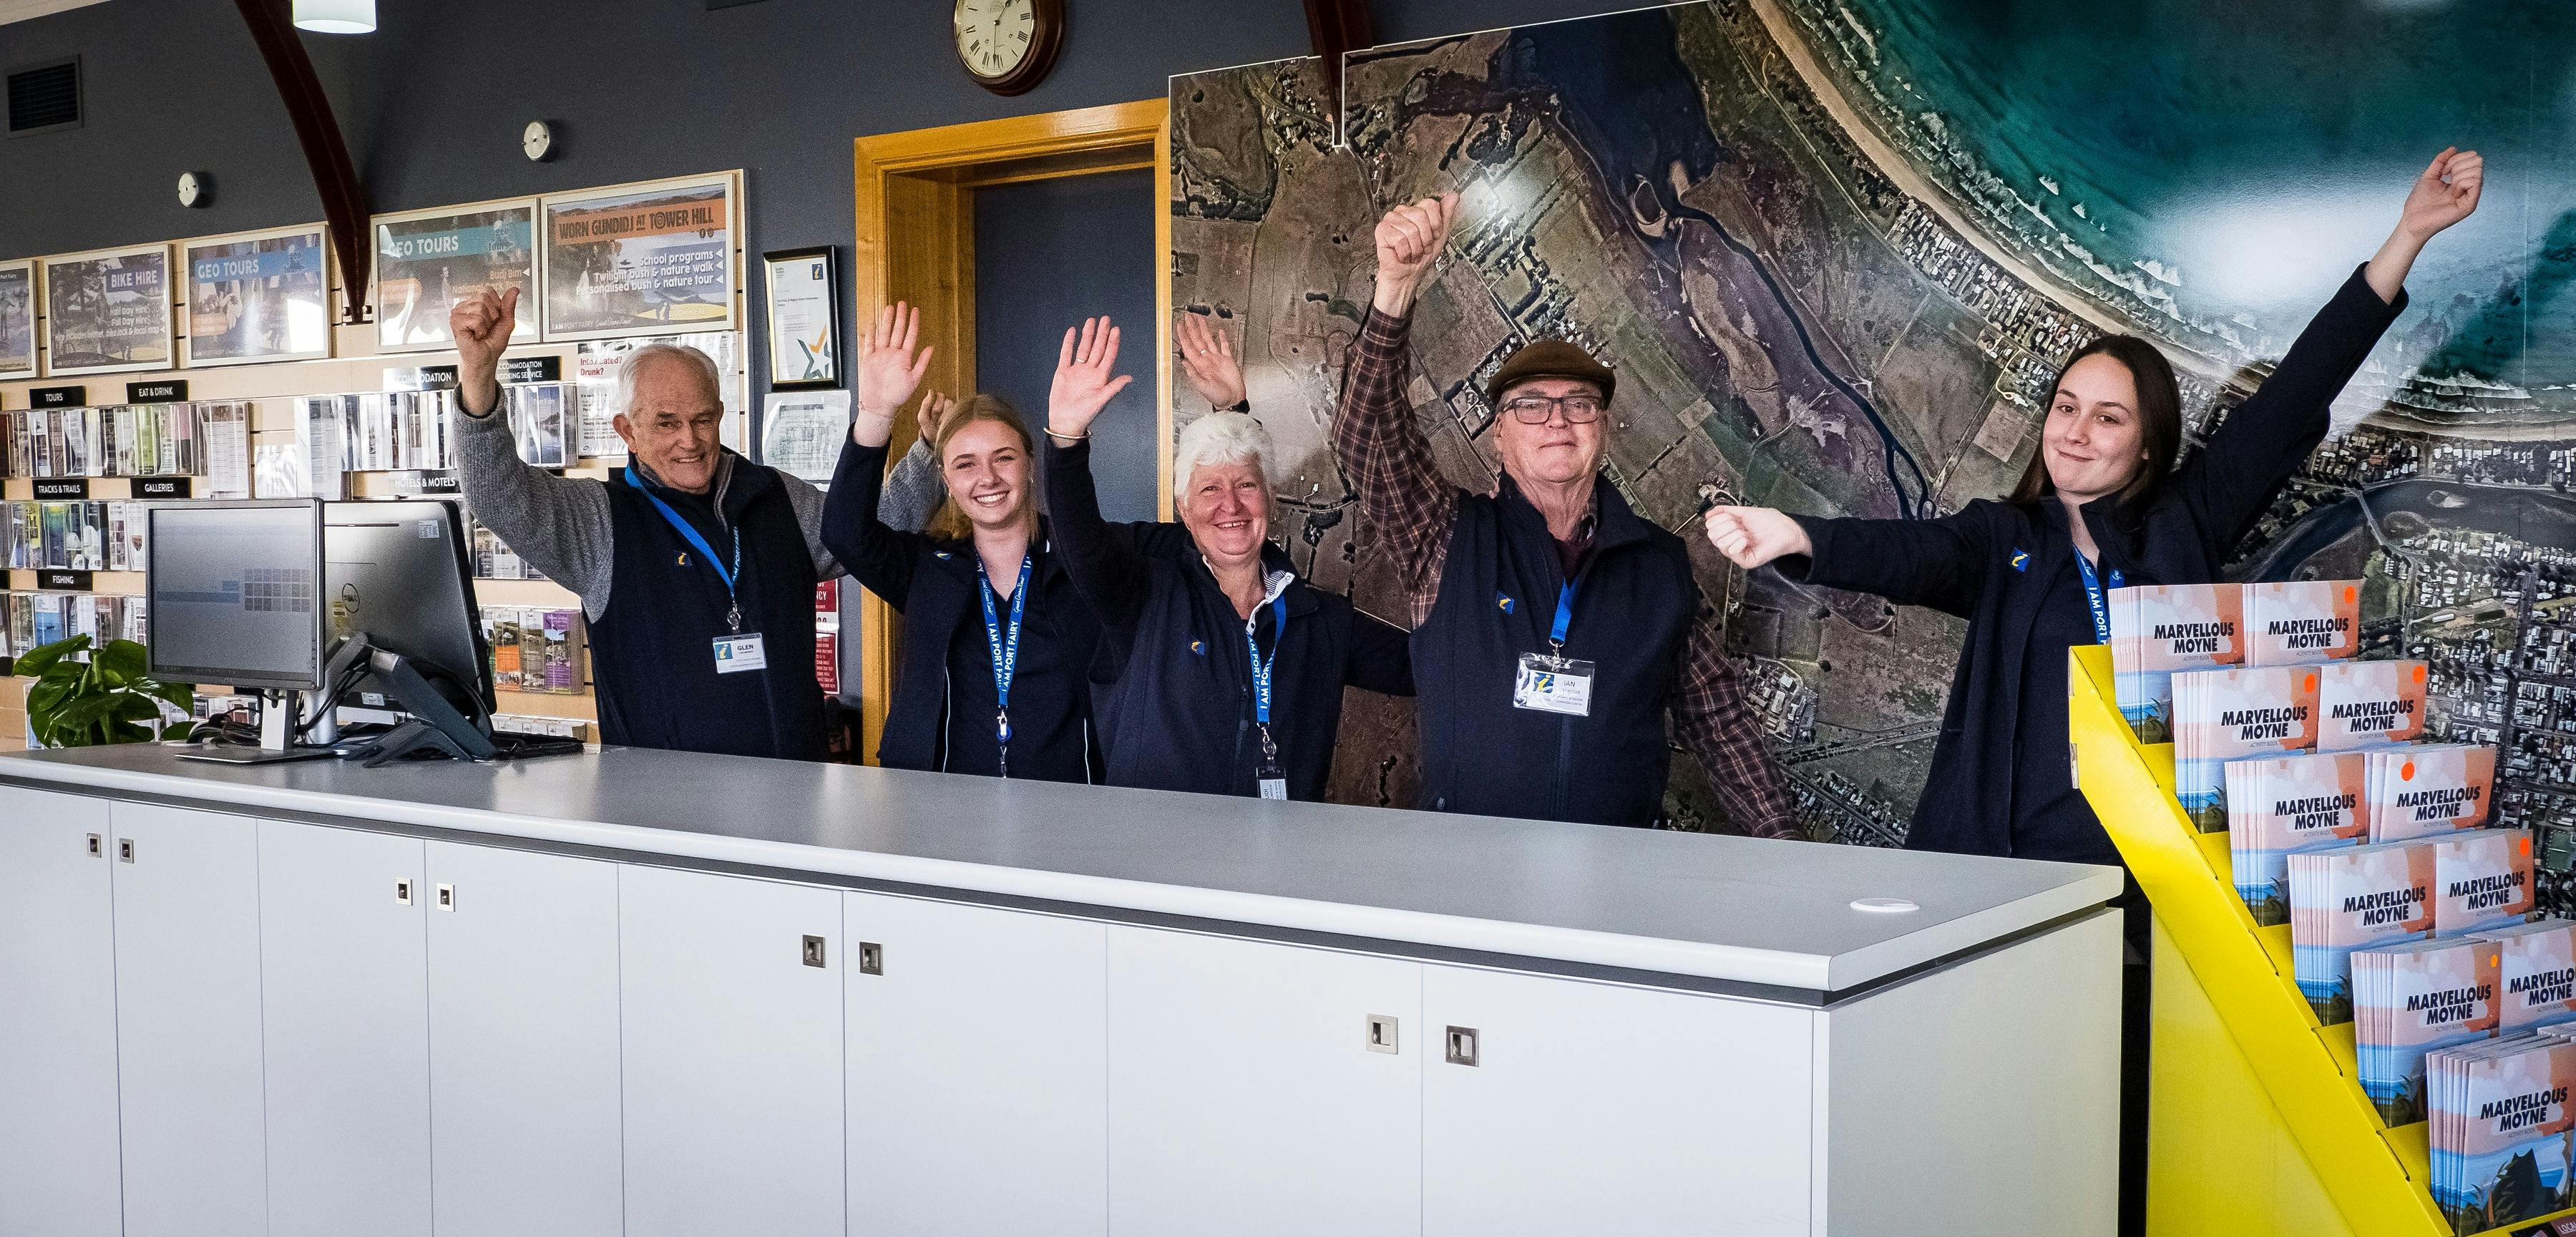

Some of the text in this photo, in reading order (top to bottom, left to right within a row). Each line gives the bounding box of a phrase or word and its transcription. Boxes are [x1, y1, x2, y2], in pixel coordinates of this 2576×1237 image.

[559, 207, 714, 240] WORN GUNDIDJ AT TOWER HILL
[416, 235, 459, 255] TOURS
[197, 258, 259, 278] GEO TOURS
[640, 251, 714, 267] School programs
[111, 270, 158, 288] BIKE HIRE
[595, 261, 714, 283] Twilight bush & nature walk
[576, 274, 714, 295] Personalised bush & nature tour
[122, 307, 135, 316] Day
[122, 318, 135, 326] Day
[580, 356, 623, 366] Intoated?
[390, 371, 452, 384] CCOMODATION
[521, 371, 542, 379] SERVICE
[580, 368, 604, 376] Drunk?
[45, 393, 63, 402] TOURS
[139, 386, 173, 397] EAT & DRINK
[38, 484, 81, 494] TRACKS & TRAILS
[145, 483, 174, 492] GALLERIES
[395, 476, 456, 487] HOTELS & MOTELS
[52, 575, 74, 585] FISHING
[2089, 592, 2102, 609] AM
[1008, 620, 1019, 645] FAIRY
[2094, 610, 2107, 637] PORT
[2155, 622, 2234, 640] MARVELLOUS
[2268, 617, 2349, 635] MARVELLOUS
[989, 628, 999, 642] AM
[2288, 633, 2331, 649] MOYNE
[992, 643, 1003, 667] PORT
[2175, 638, 2218, 654] MOYNE
[1005, 646, 1015, 671] PORT
[1252, 653, 1261, 678] PORT
[1003, 673, 1011, 688] AM
[1260, 688, 1269, 705] AM
[2221, 706, 2308, 726] MARVELLOUS
[2332, 700, 2414, 718] MARVELLOUS
[2241, 723, 2288, 740] MOYNE
[2351, 715, 2395, 732] MOYNE
[2275, 793, 2356, 816] MARVELLOUS
[2397, 786, 2481, 807] MARVELLOUS
[2295, 811, 2339, 830] MOYNE
[2416, 803, 2461, 821] MOYNE
[2449, 871, 2524, 897] MARVELLOUS
[2343, 886, 2426, 913] MARVELLOUS
[2468, 889, 2509, 910] MOYNE
[2363, 905, 2409, 926] MOYNE
[2509, 967, 2576, 994] MARVELLO
[2406, 984, 2491, 1011] MARVELLOUS
[2528, 984, 2572, 1006] MOYNE
[2426, 1003, 2473, 1025] MOYNE
[2480, 1087, 2568, 1120] MARVELLOUS
[2499, 1107, 2547, 1132] MOYNE
